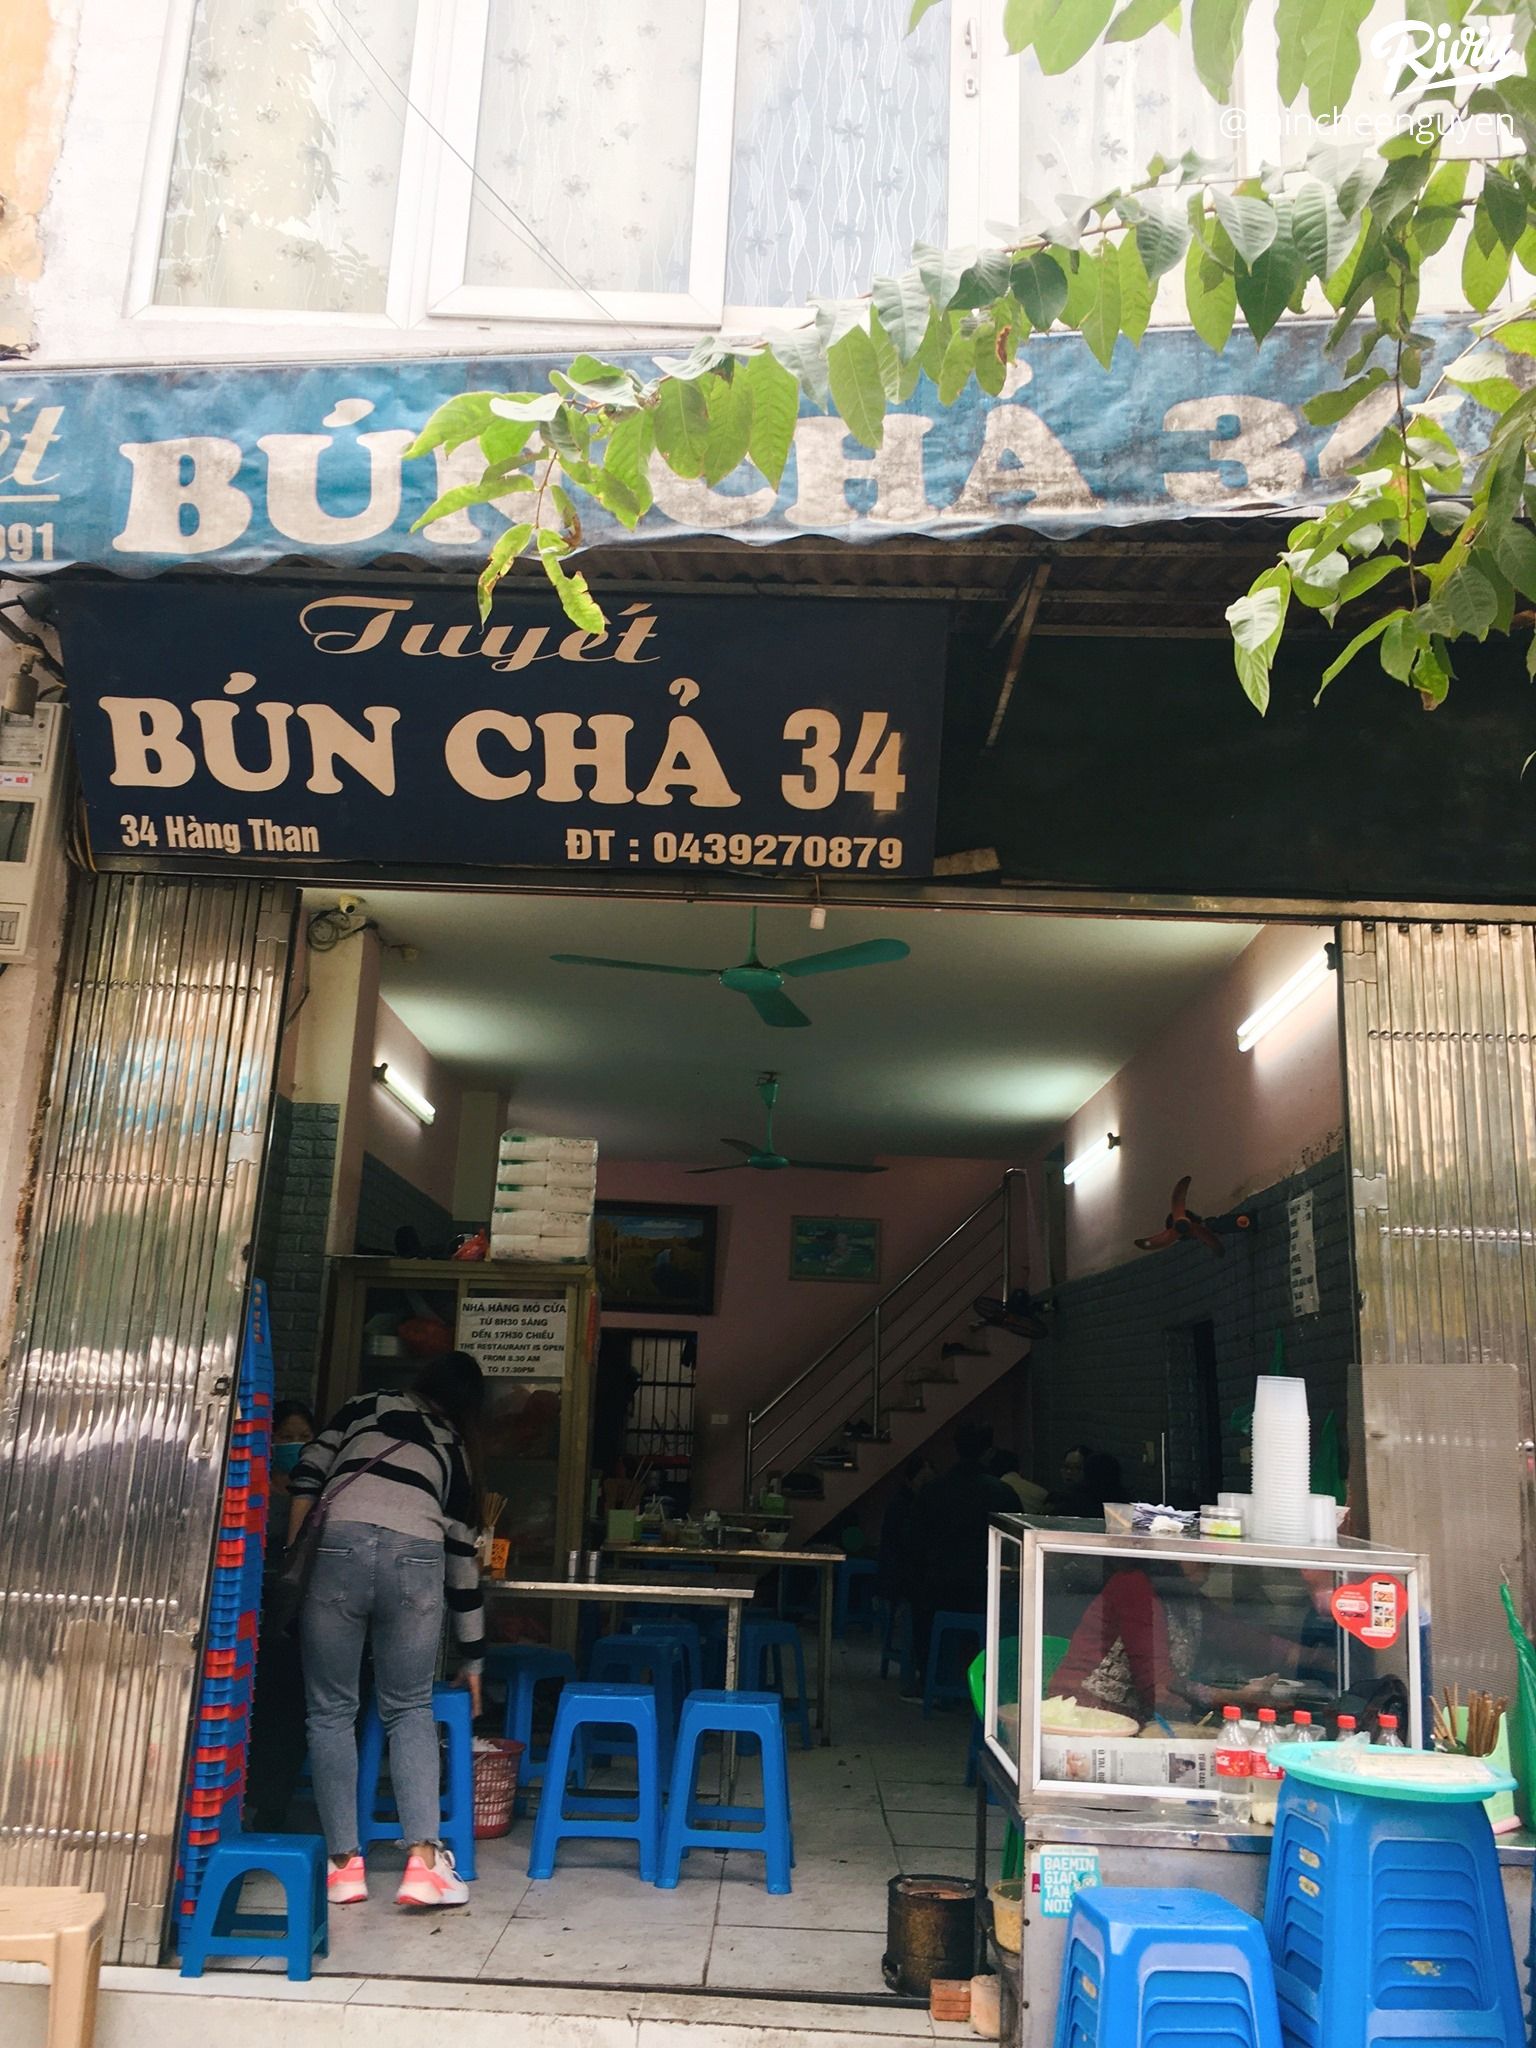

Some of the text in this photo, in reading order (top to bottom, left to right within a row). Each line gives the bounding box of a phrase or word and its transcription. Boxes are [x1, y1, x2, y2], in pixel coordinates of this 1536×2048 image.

[0, 522, 54, 562] 91
[299, 595, 661, 672] Tuyết
[98, 671, 401, 797] BÚN
[444, 677, 742, 808] CHẢ
[781, 708, 906, 811] 34
[120, 814, 321, 854] 34 Hàng Than
[565, 827, 616, 862] ĐT
[653, 831, 903, 869] 0439270879
[477, 1343, 531, 1351] RESTAURANT
[1043, 1857, 1095, 1872] BAEMIN
[1043, 1871, 1077, 1885] GIAO
